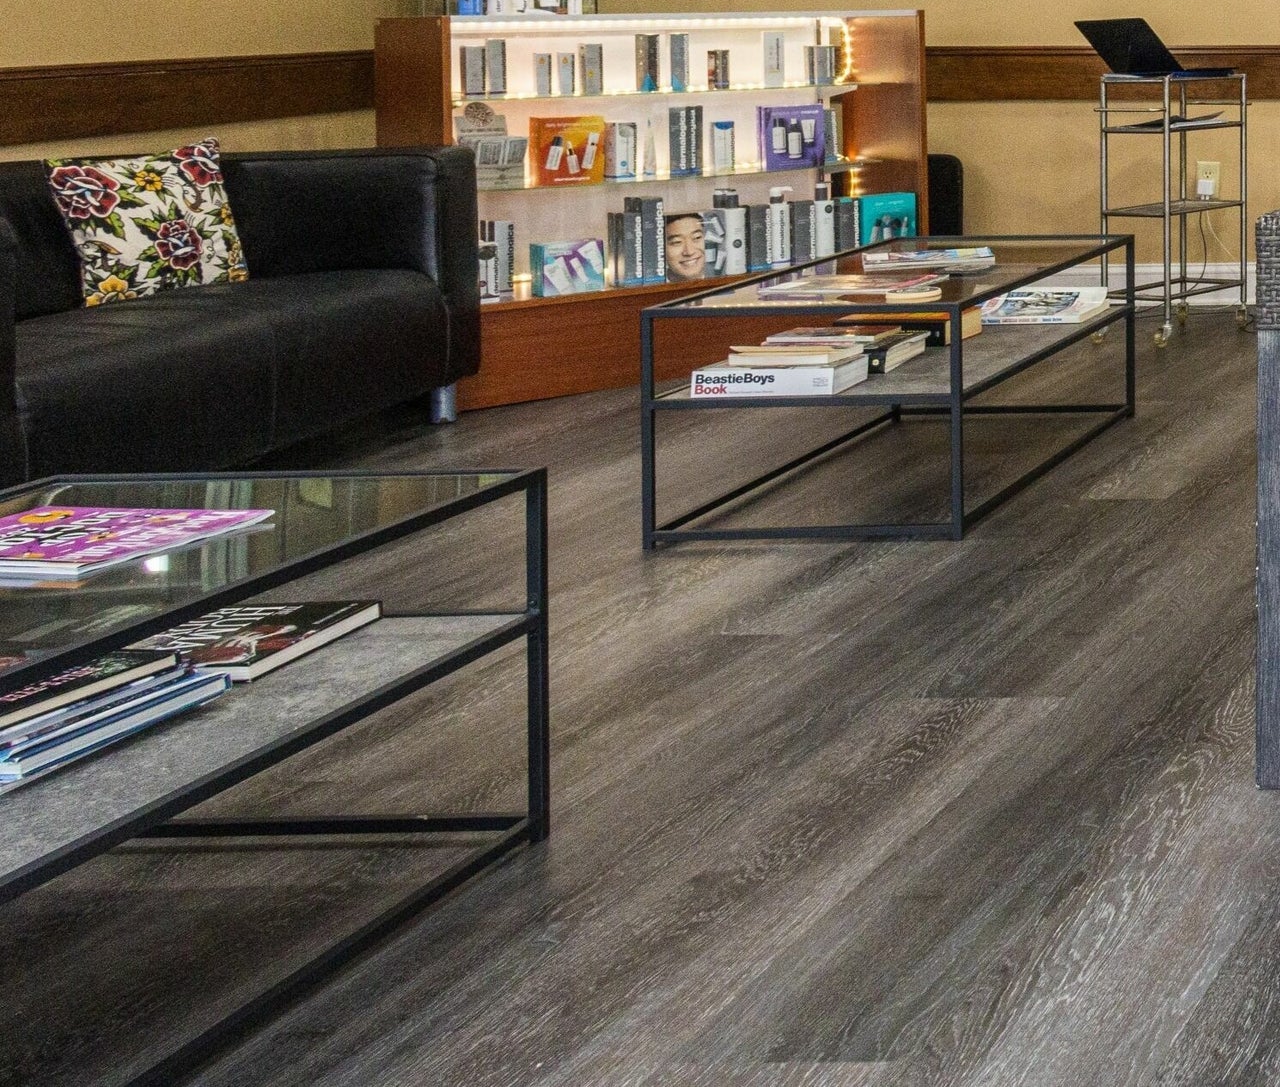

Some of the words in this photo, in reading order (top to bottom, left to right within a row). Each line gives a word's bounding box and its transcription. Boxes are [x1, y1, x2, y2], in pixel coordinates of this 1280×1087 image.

[656, 201, 665, 278] dermalogica
[694, 383, 728, 395] Book
[695, 373, 775, 385] BeastieBoys
[155, 605, 287, 651] HUMA
